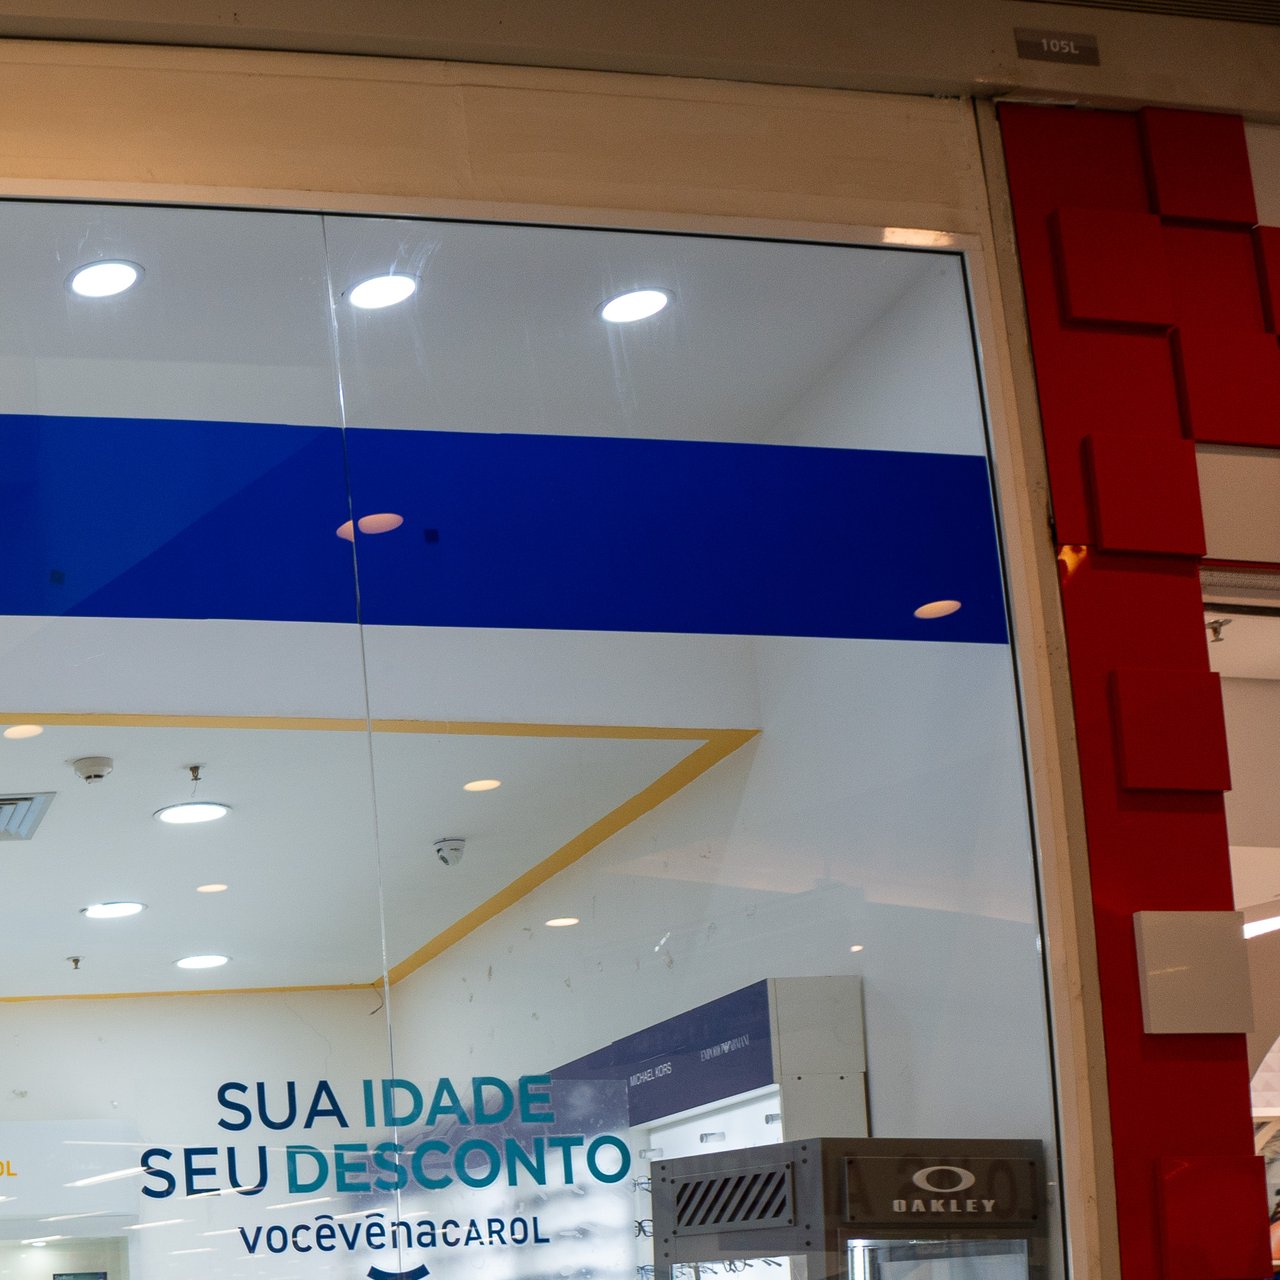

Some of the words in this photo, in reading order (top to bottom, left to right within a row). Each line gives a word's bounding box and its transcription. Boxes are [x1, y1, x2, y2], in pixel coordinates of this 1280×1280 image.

[630, 1069, 655, 1087] MICHAEL
[655, 1062, 672, 1078] KORS
[217, 1080, 349, 1132] SUA
[363, 1074, 555, 1128] IDADE
[140, 1146, 269, 1199] SEU
[287, 1135, 632, 1195] DESCONTO
[892, 1198, 996, 1213] OAKLEY
